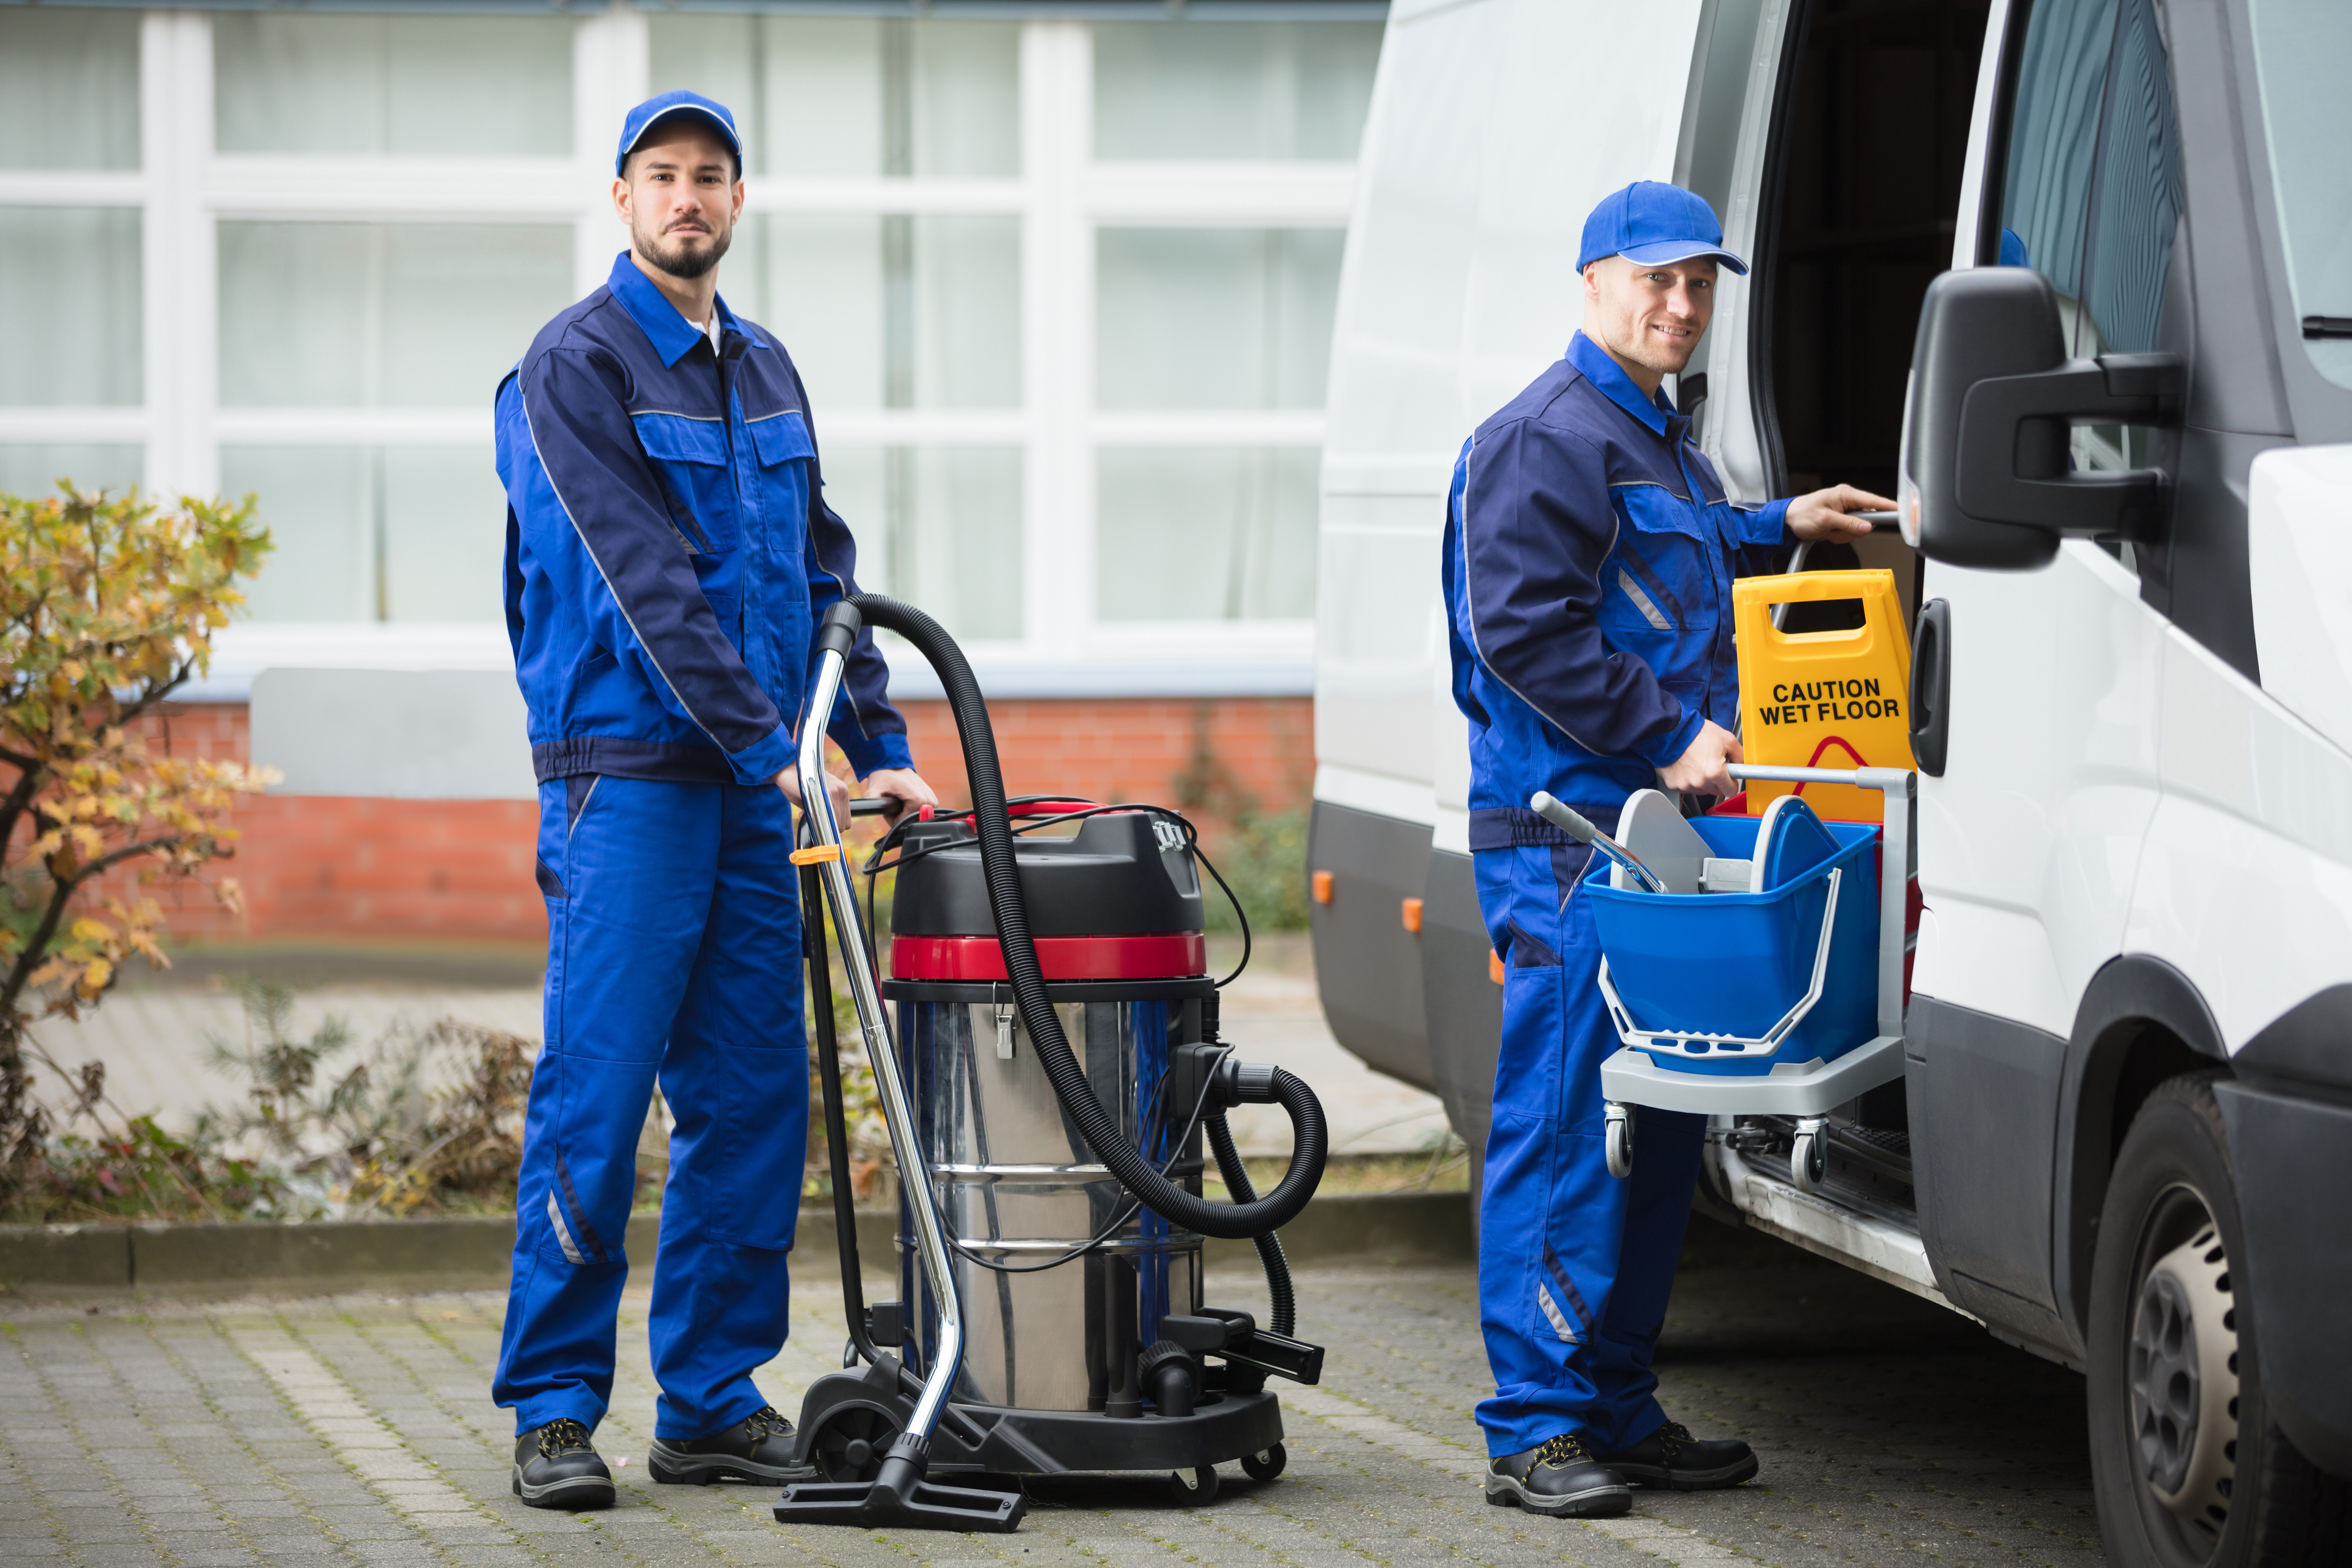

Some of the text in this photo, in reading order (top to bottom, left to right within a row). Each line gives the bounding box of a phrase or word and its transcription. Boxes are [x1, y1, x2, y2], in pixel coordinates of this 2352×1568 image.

[1773, 678, 1880, 702] CAUTION
[1759, 699, 1899, 726] WET FLOOR
